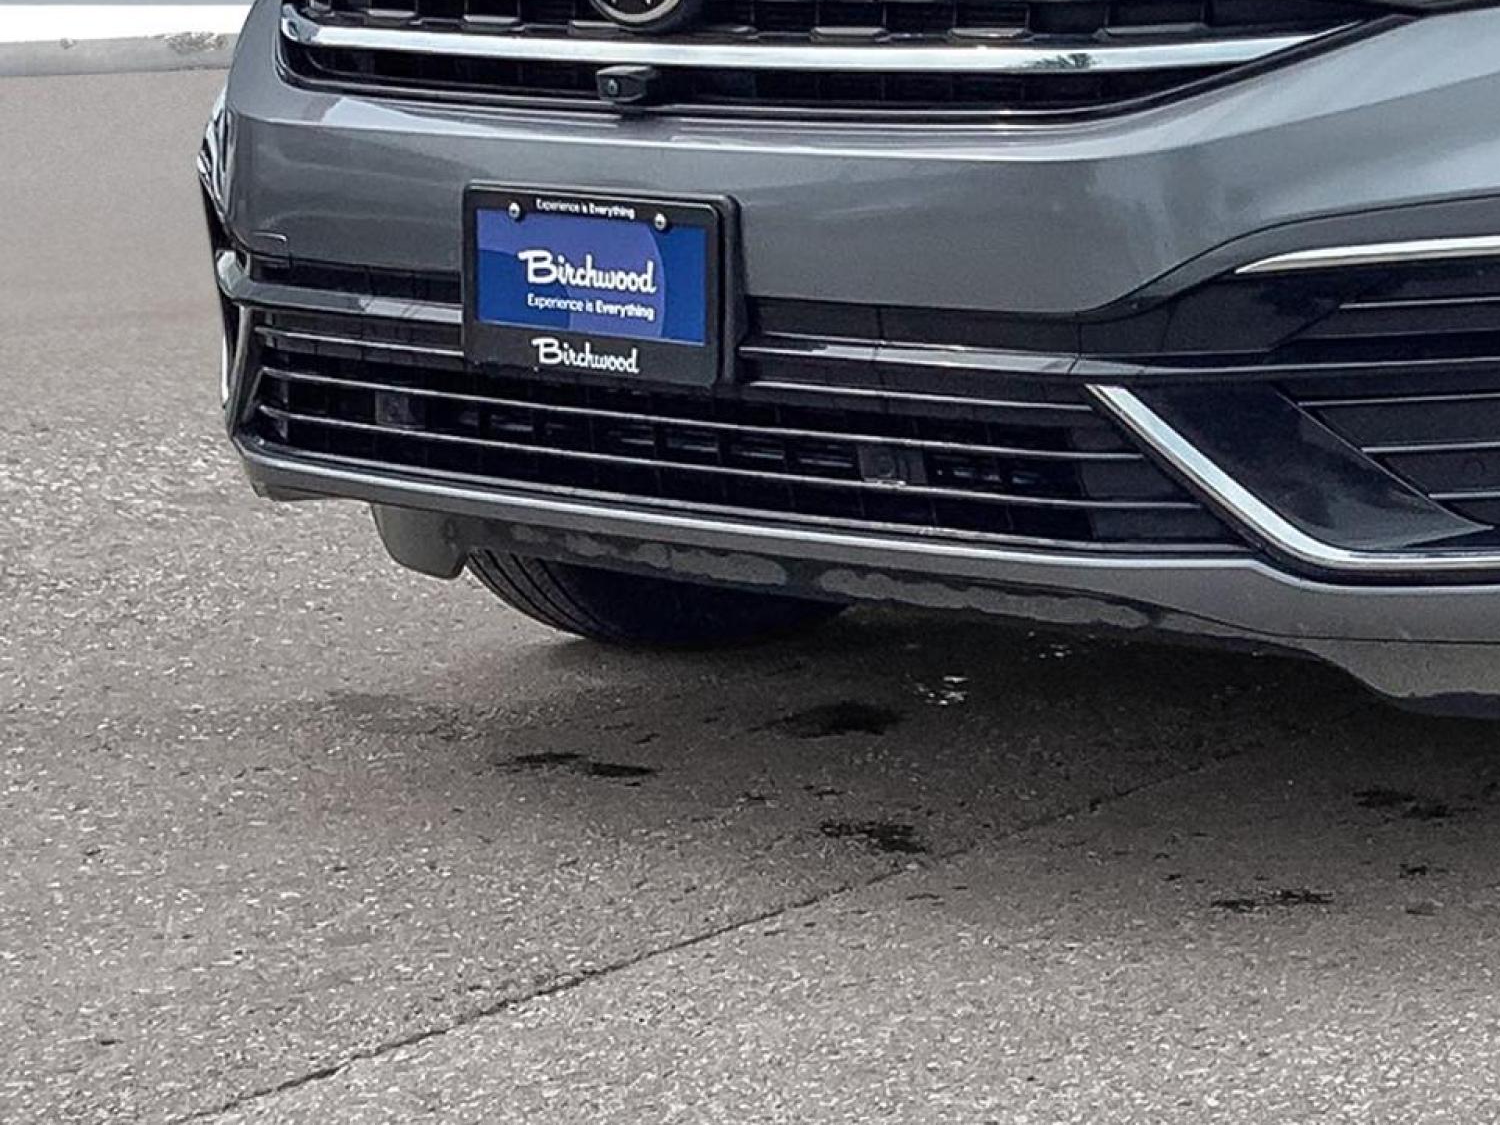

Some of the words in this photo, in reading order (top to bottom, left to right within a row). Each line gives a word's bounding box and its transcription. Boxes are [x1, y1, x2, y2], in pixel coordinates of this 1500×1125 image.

[518, 249, 656, 293] Birchwood
[527, 293, 583, 312] Experience
[585, 299, 593, 313] is
[596, 299, 655, 321] Everything
[531, 337, 640, 374] Birchwood
